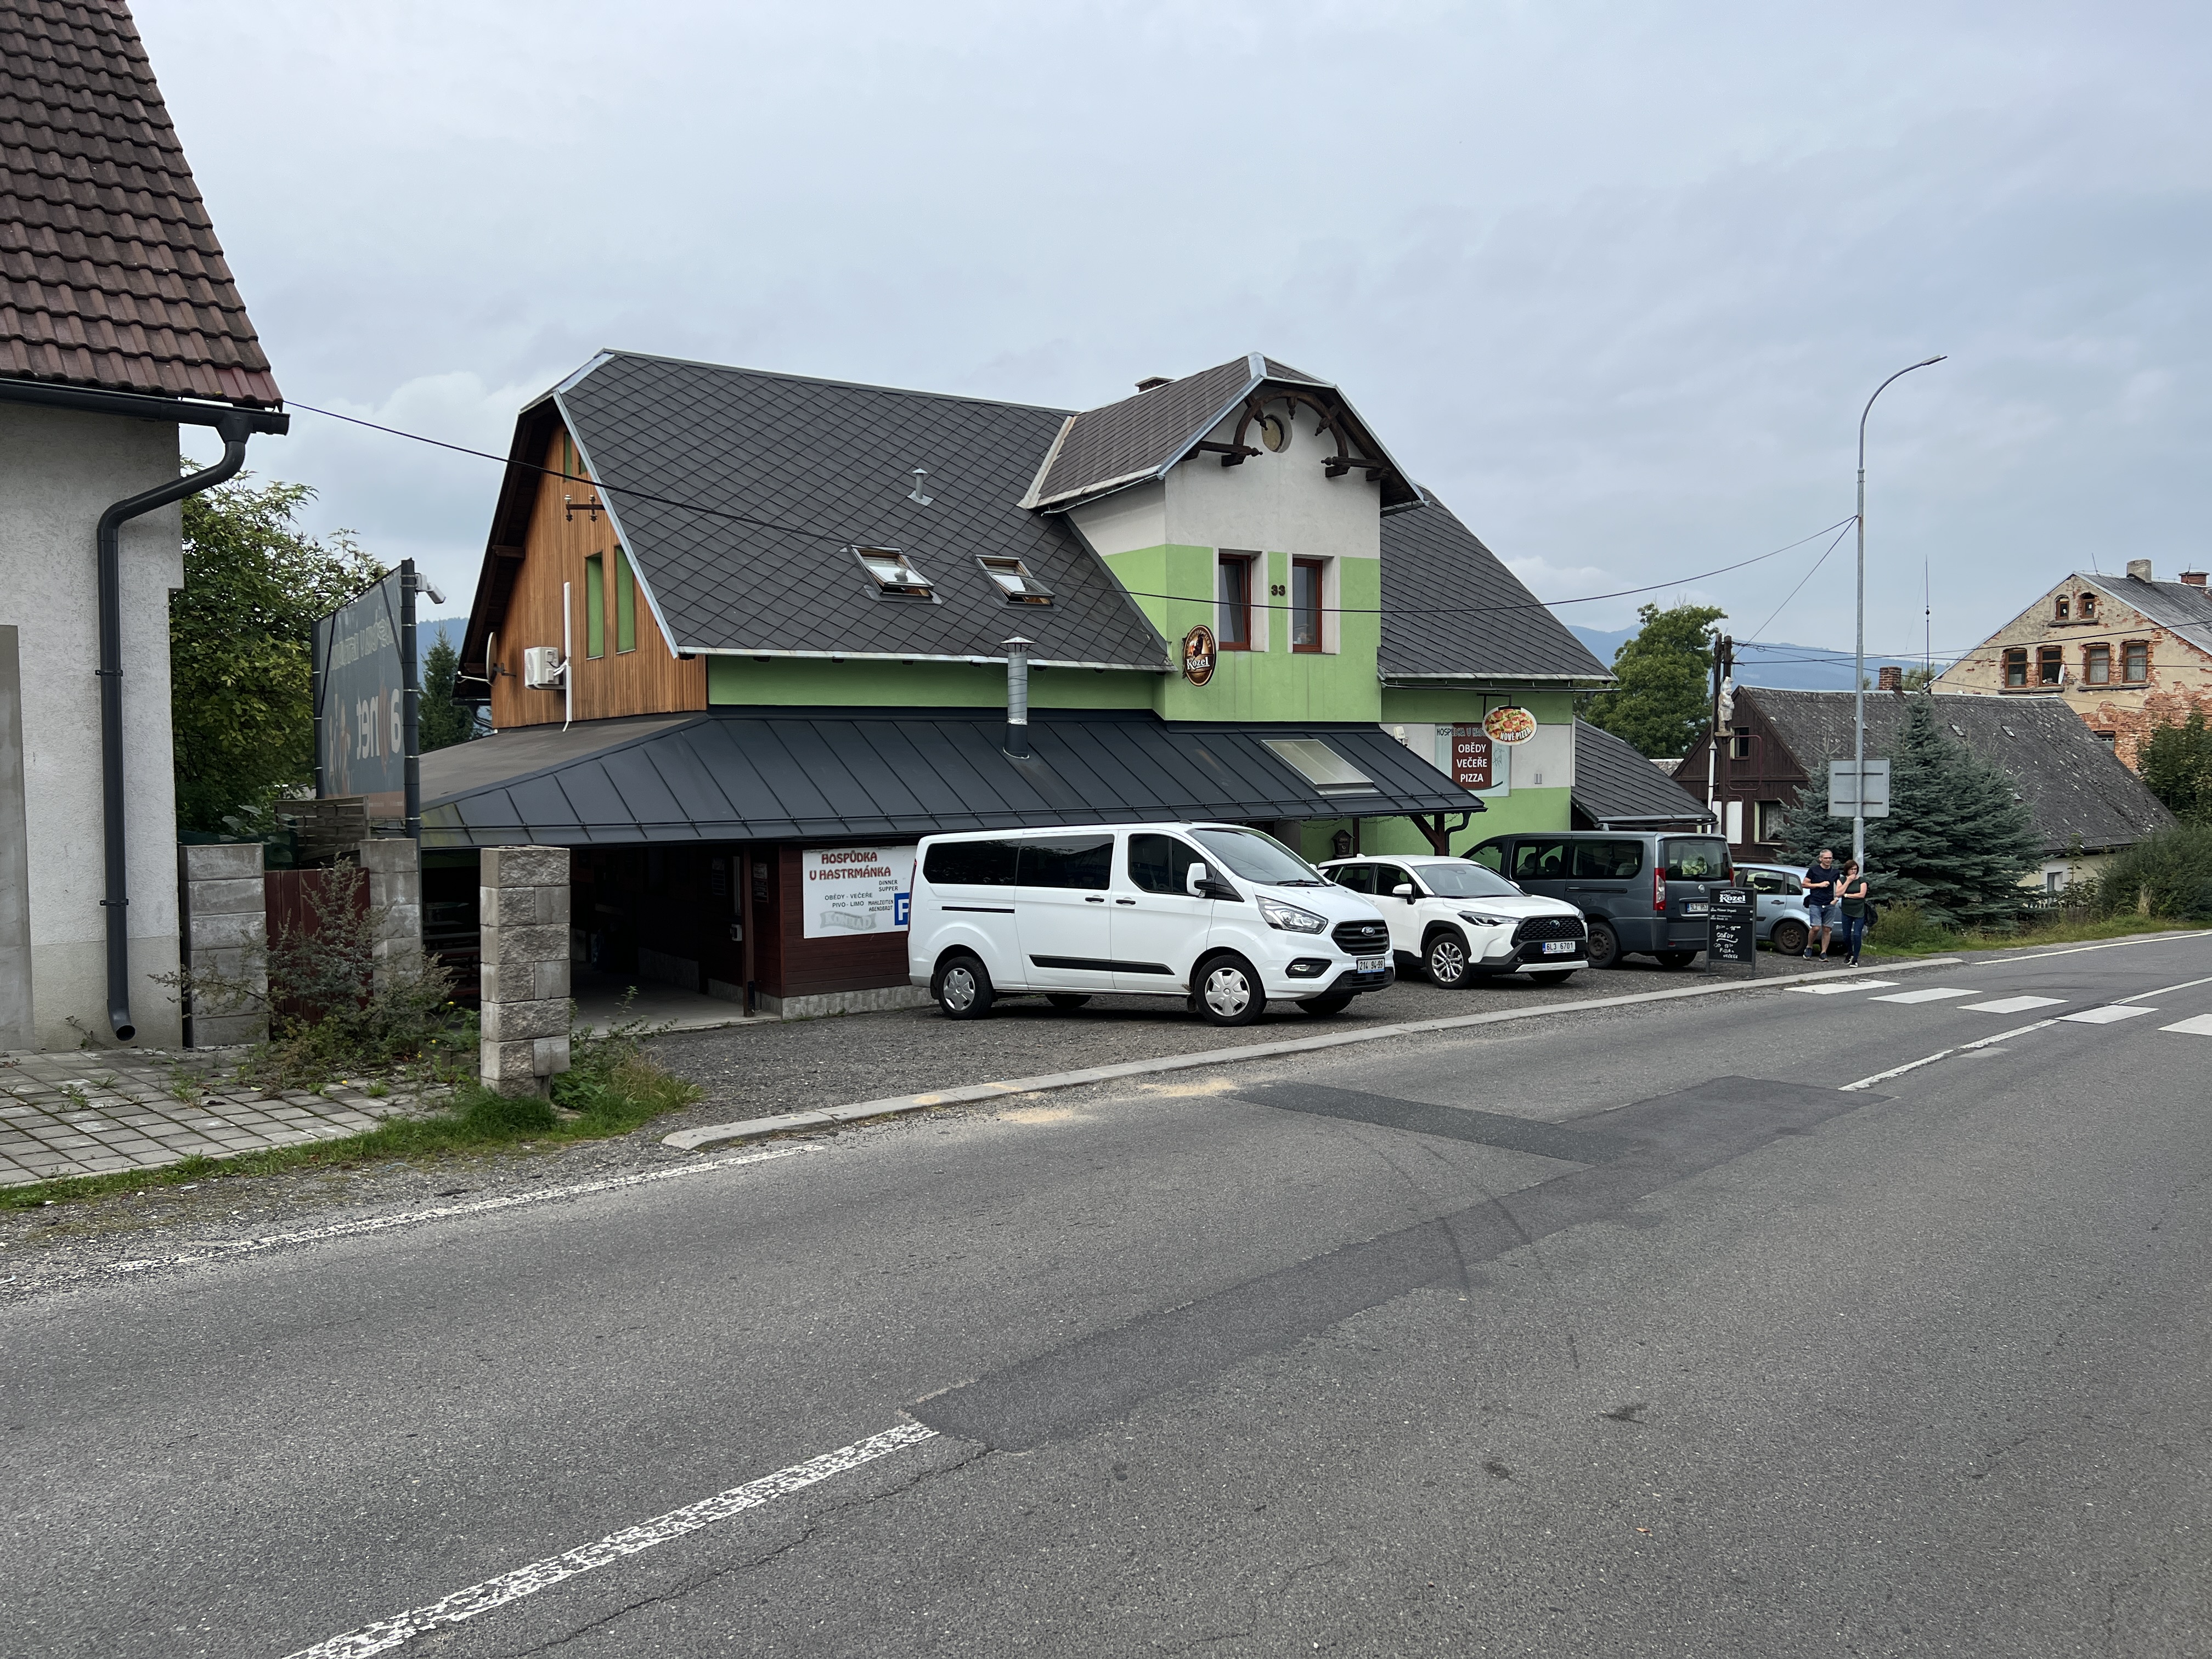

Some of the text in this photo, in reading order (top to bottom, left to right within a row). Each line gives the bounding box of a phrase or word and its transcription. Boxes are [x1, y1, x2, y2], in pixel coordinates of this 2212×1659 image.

[1271, 584, 1286, 596] 33
[1186, 657, 1210, 670] Kozel
[1466, 727, 1471, 737] U
[1516, 727, 1532, 741] PIZZA
[1458, 742, 1487, 753] OBĚDY
[1456, 757, 1487, 768] VEČEŘE
[1460, 774, 1484, 783] PIZZA
[821, 850, 877, 864] HOSPŮDKA
[809, 865, 891, 881] U HASTRMÁNKA
[1719, 894, 1746, 904] Kozel
[824, 911, 872, 929] KONRAD
[1547, 943, 1557, 951] 6L3
[1359, 961, 1368, 970] 214
